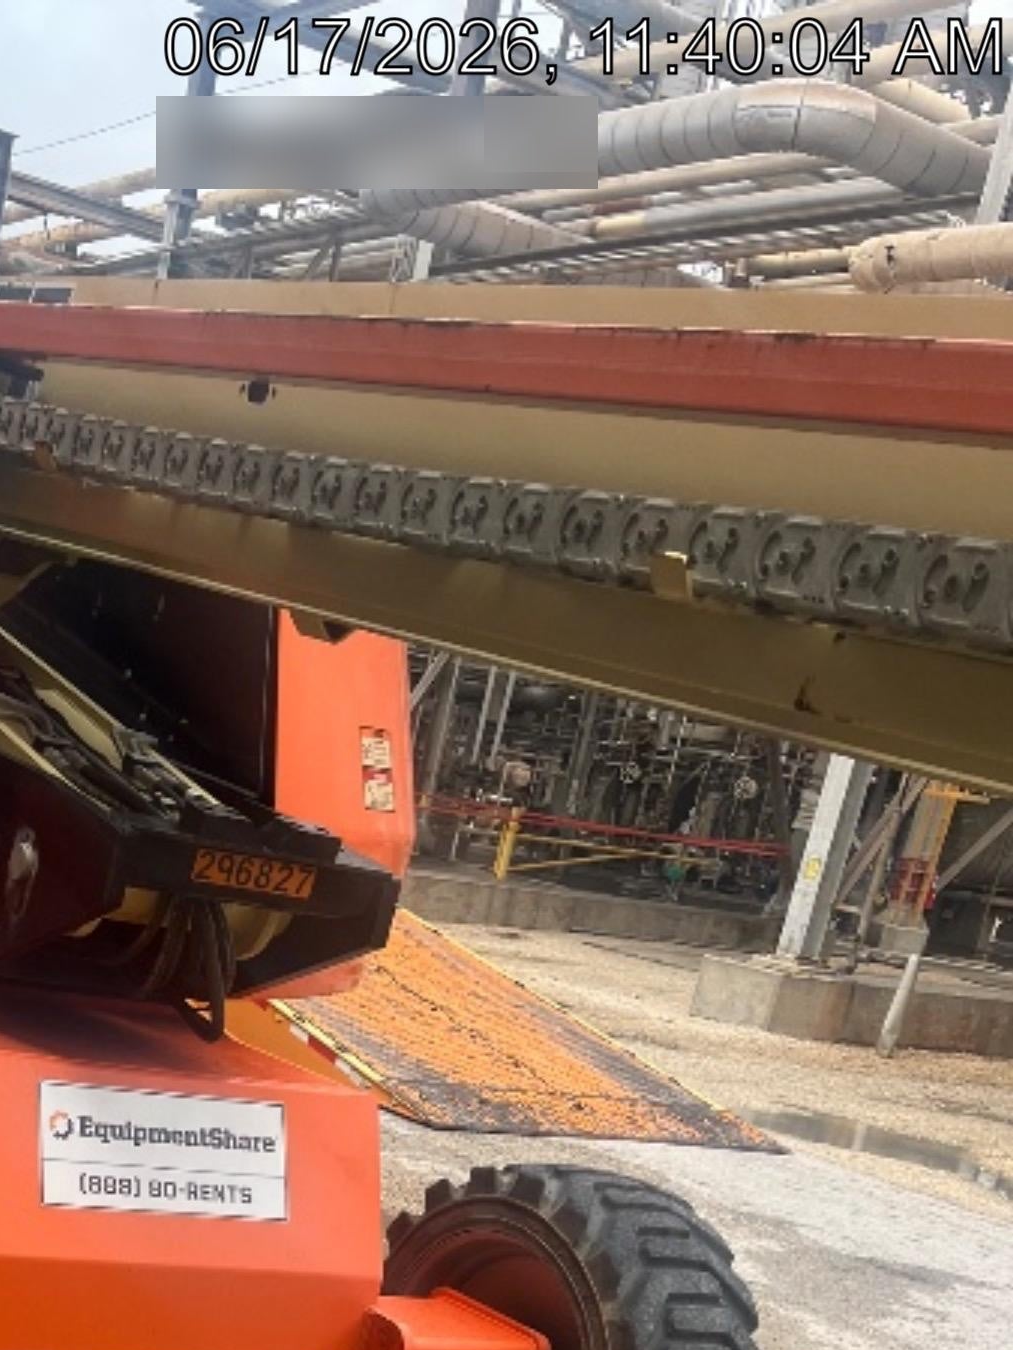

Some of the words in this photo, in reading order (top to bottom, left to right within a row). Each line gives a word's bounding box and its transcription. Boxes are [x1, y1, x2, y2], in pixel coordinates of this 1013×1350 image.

[189, 850, 316, 895] 296827
[77, 1115, 276, 1153] EquipmentShare
[79, 1172, 141, 1198] (888)
[148, 1179, 252, 1205] 80-RENTS
